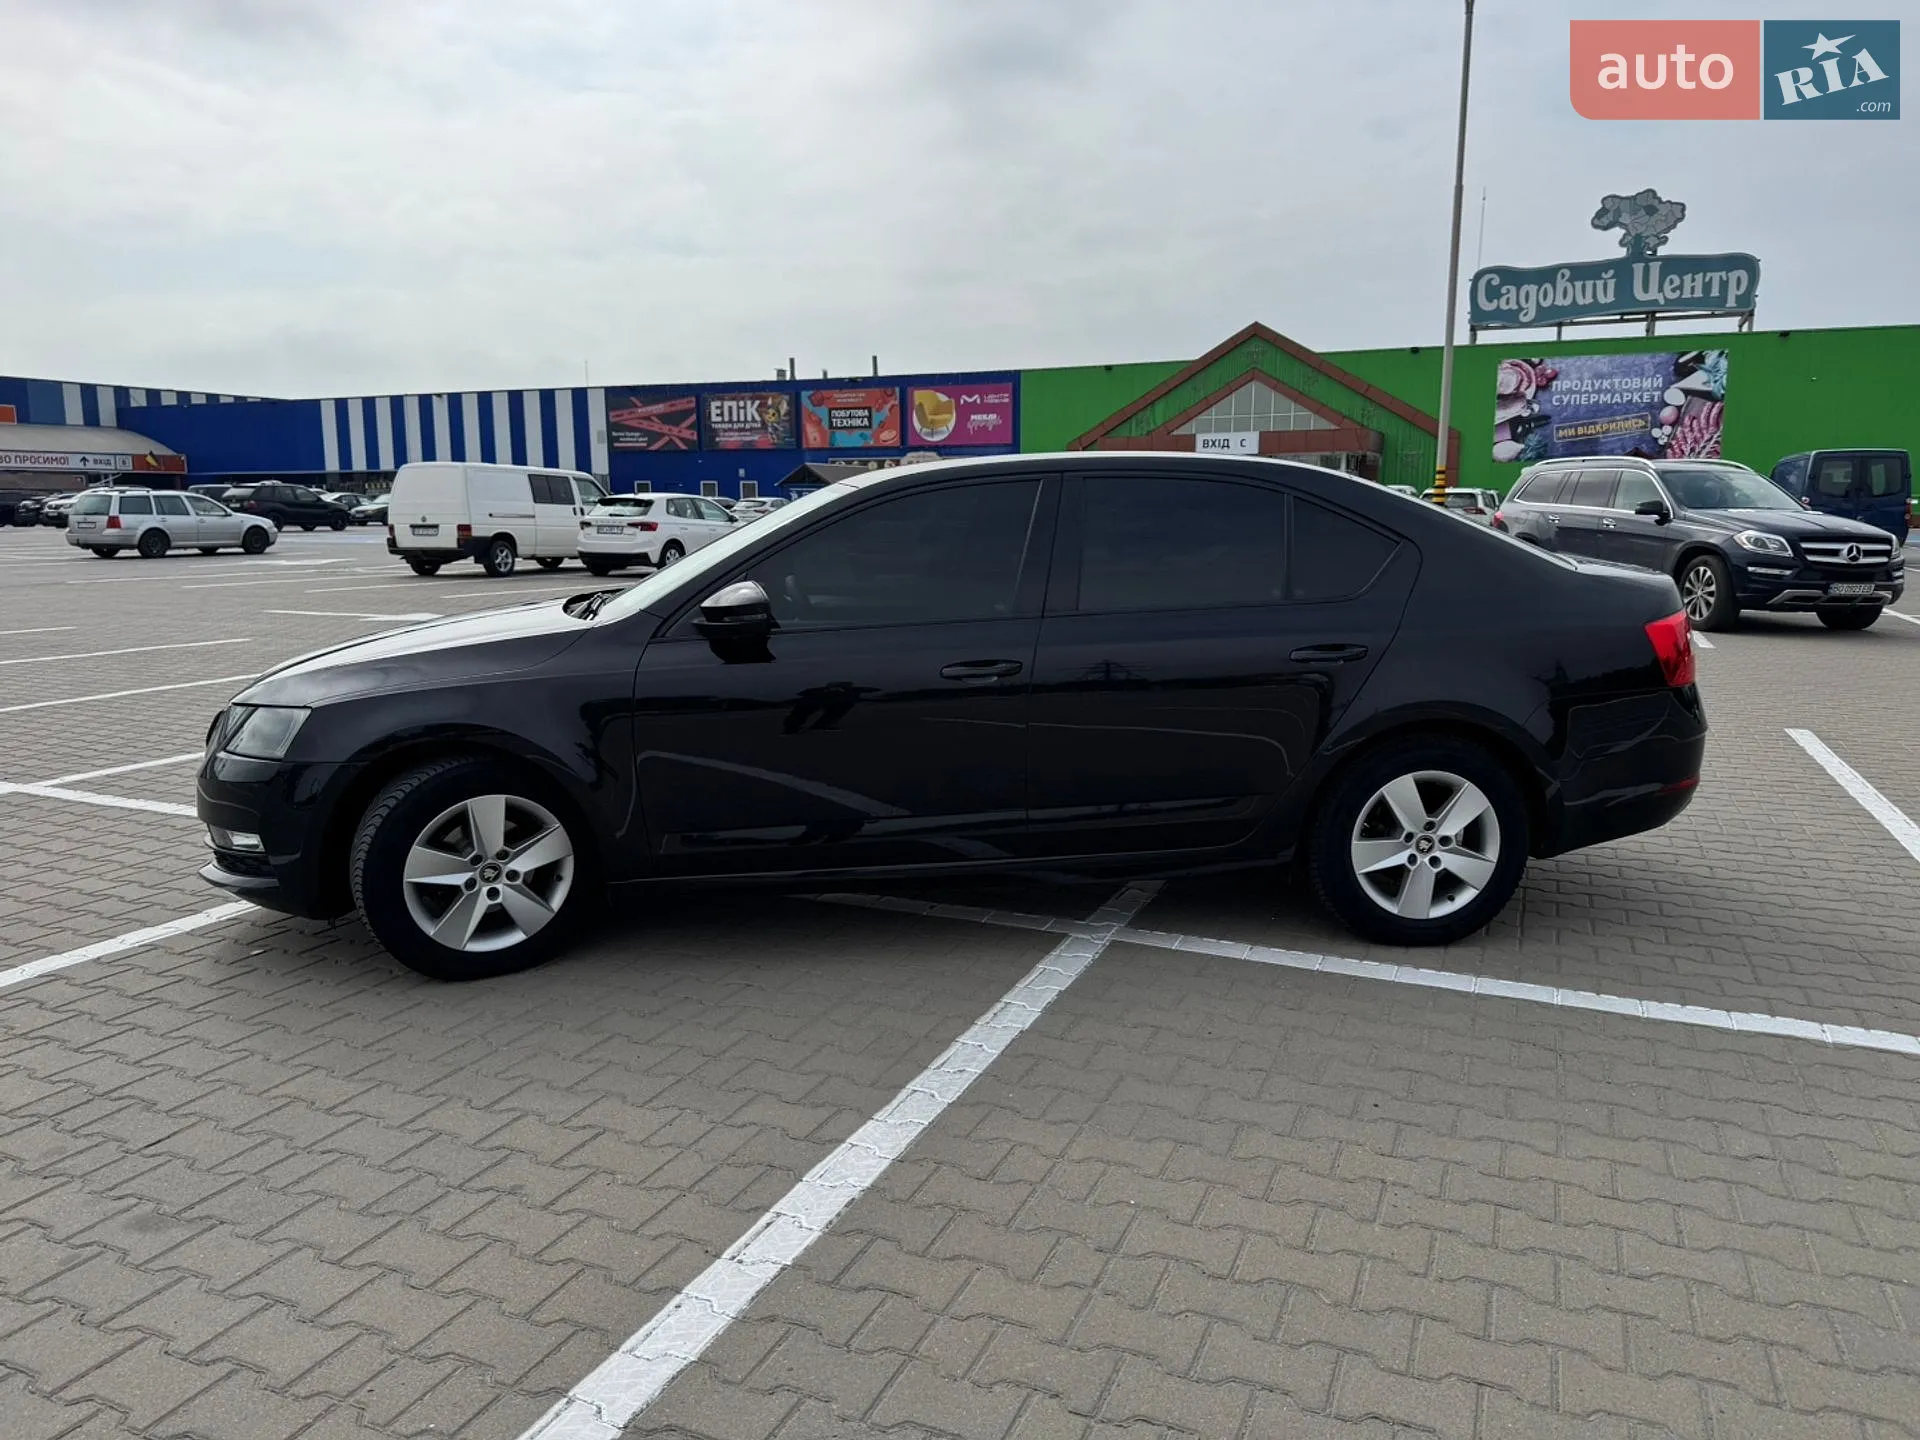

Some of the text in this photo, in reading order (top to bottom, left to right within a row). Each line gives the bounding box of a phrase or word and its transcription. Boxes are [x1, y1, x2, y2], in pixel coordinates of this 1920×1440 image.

[1476, 261, 1748, 323] Садовий Центр
[1551, 376, 1663, 392] ПРОДУКТОВИЙ
[1551, 391, 1662, 406] СУПЕРМАРКЕТ
[831, 409, 869, 417] ПОБУТОВА
[831, 417, 869, 427] ТЕХНІКА
[1557, 419, 1646, 438] МИ ВІДКРИЛИСЬ
[1202, 438, 1230, 449] ВХІД
